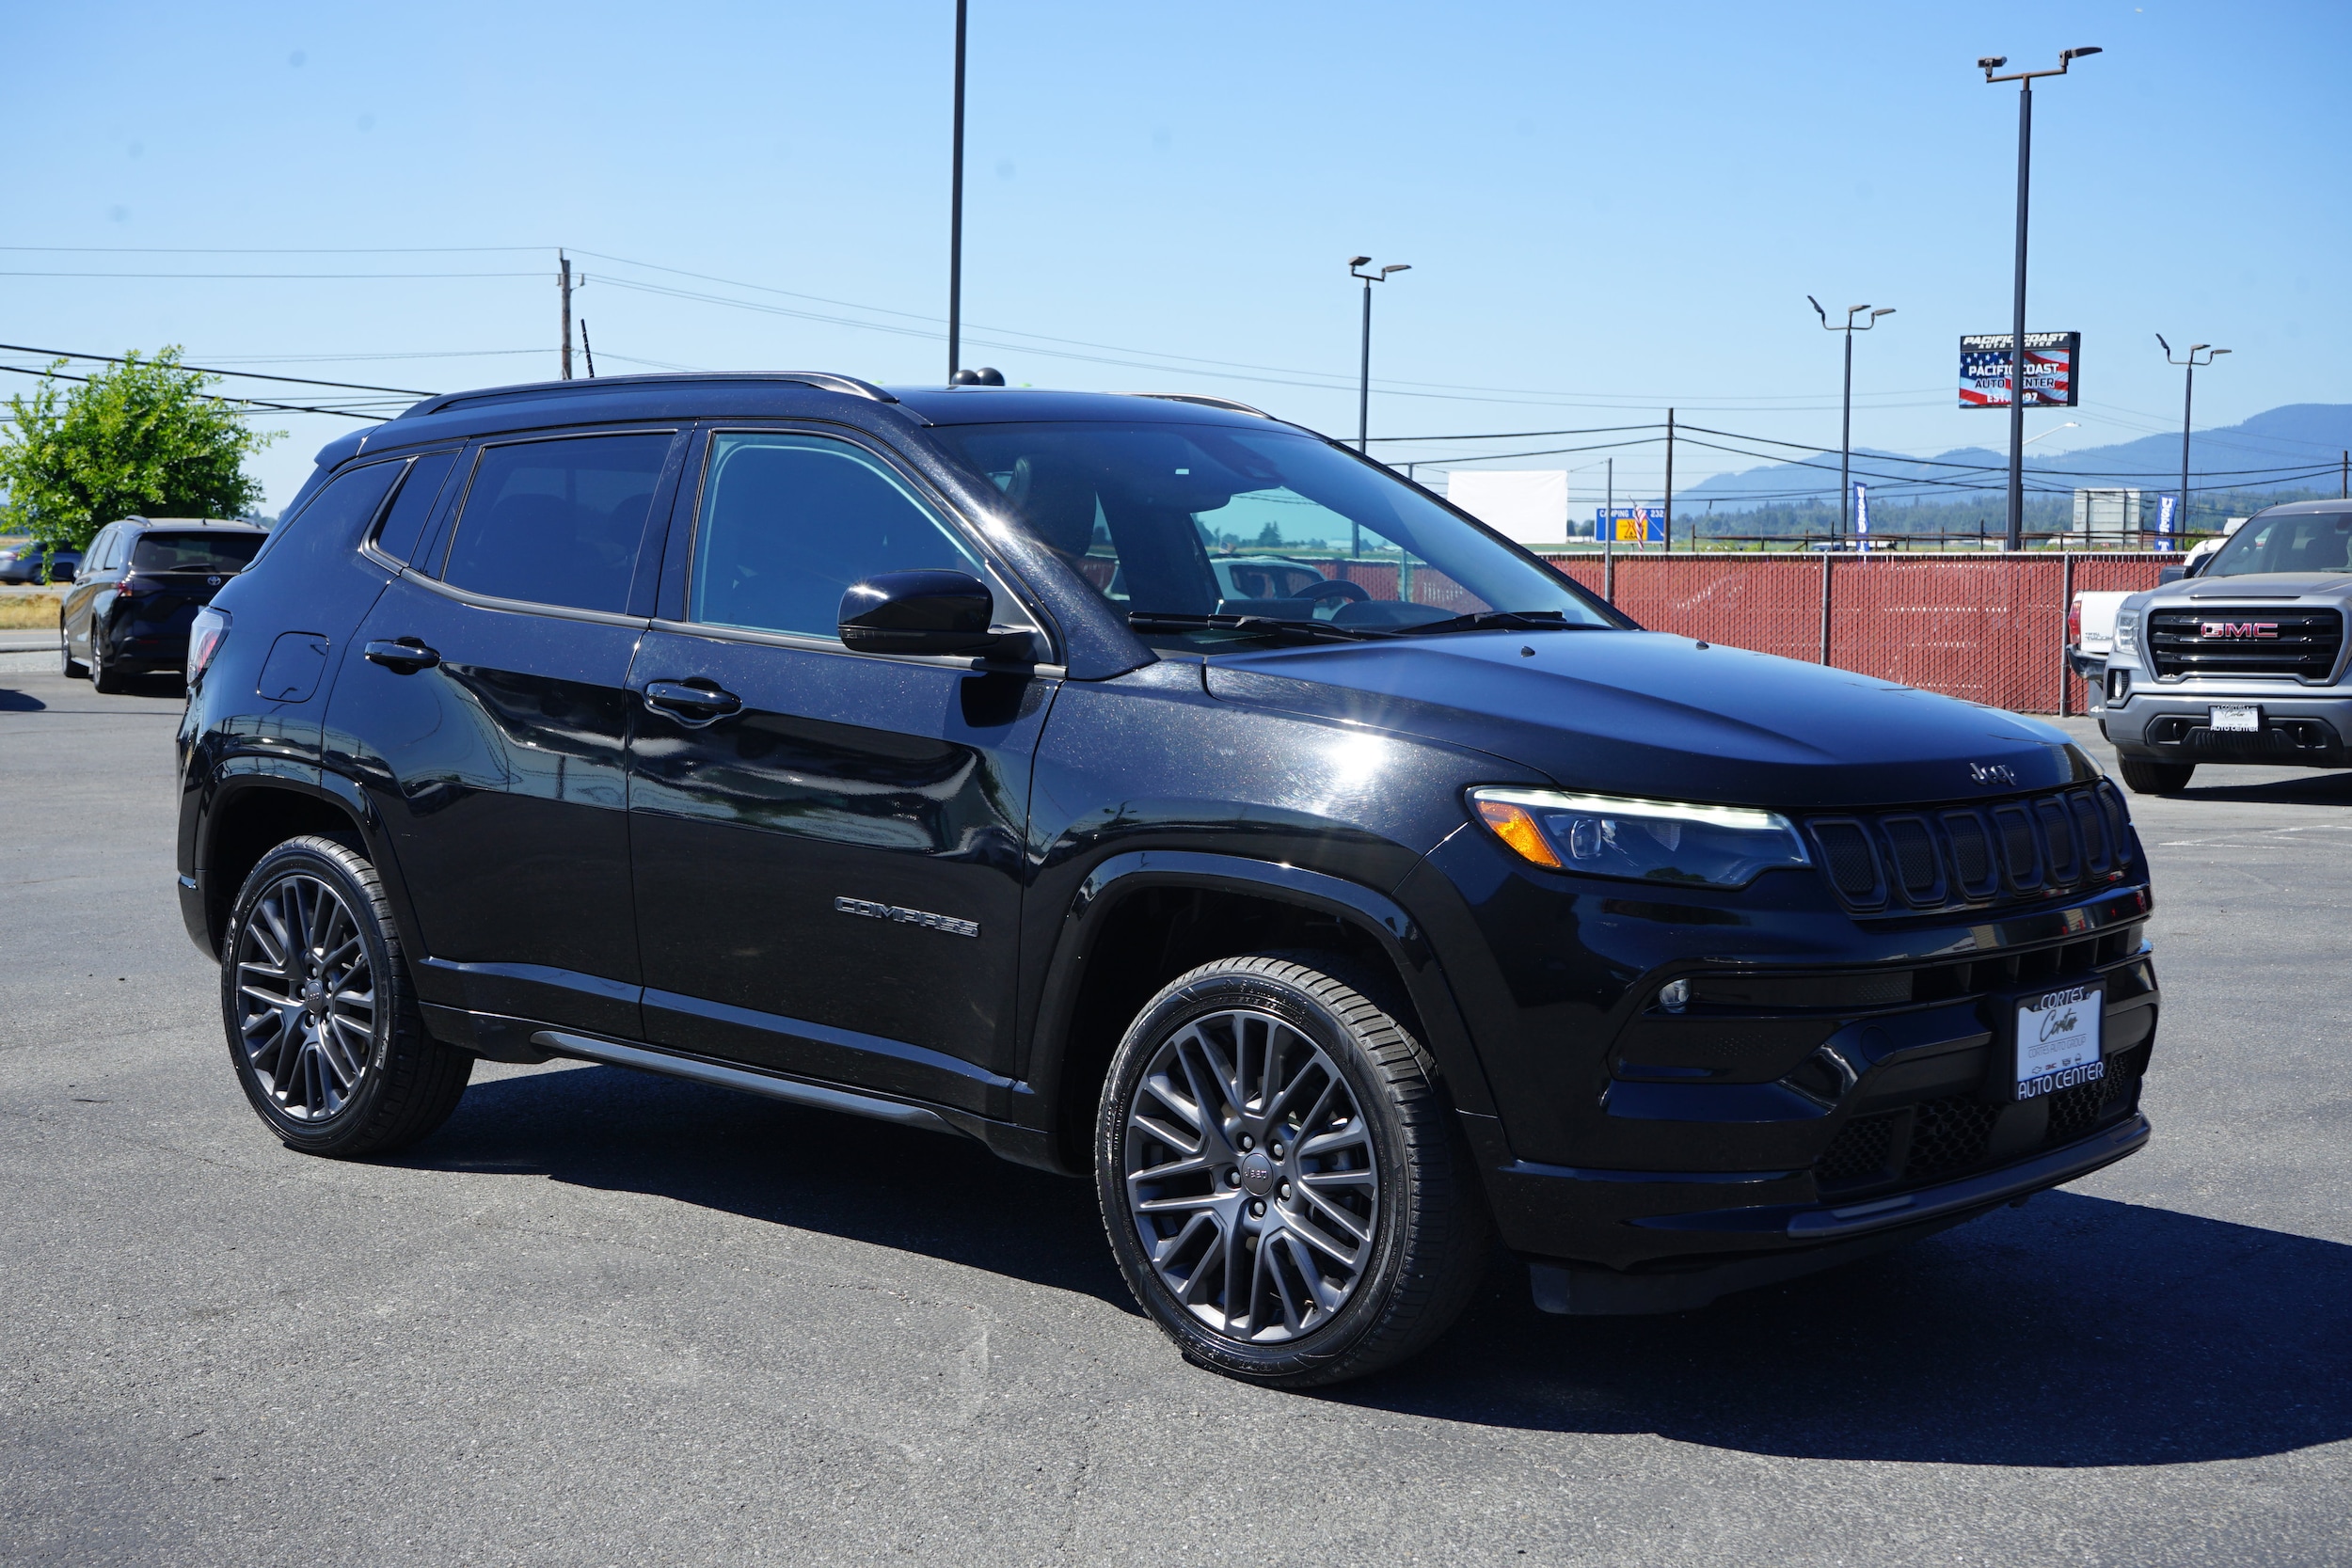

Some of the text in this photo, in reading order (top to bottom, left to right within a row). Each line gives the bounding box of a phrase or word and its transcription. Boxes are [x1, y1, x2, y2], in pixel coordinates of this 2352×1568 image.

[1975, 378, 2006, 388] AUTO
[2201, 623, 2278, 638] GMC
[834, 896, 980, 938] COMPASS
[2041, 986, 2085, 1010] CORTES
[2018, 1061, 2104, 1101] AUTO CENTER
